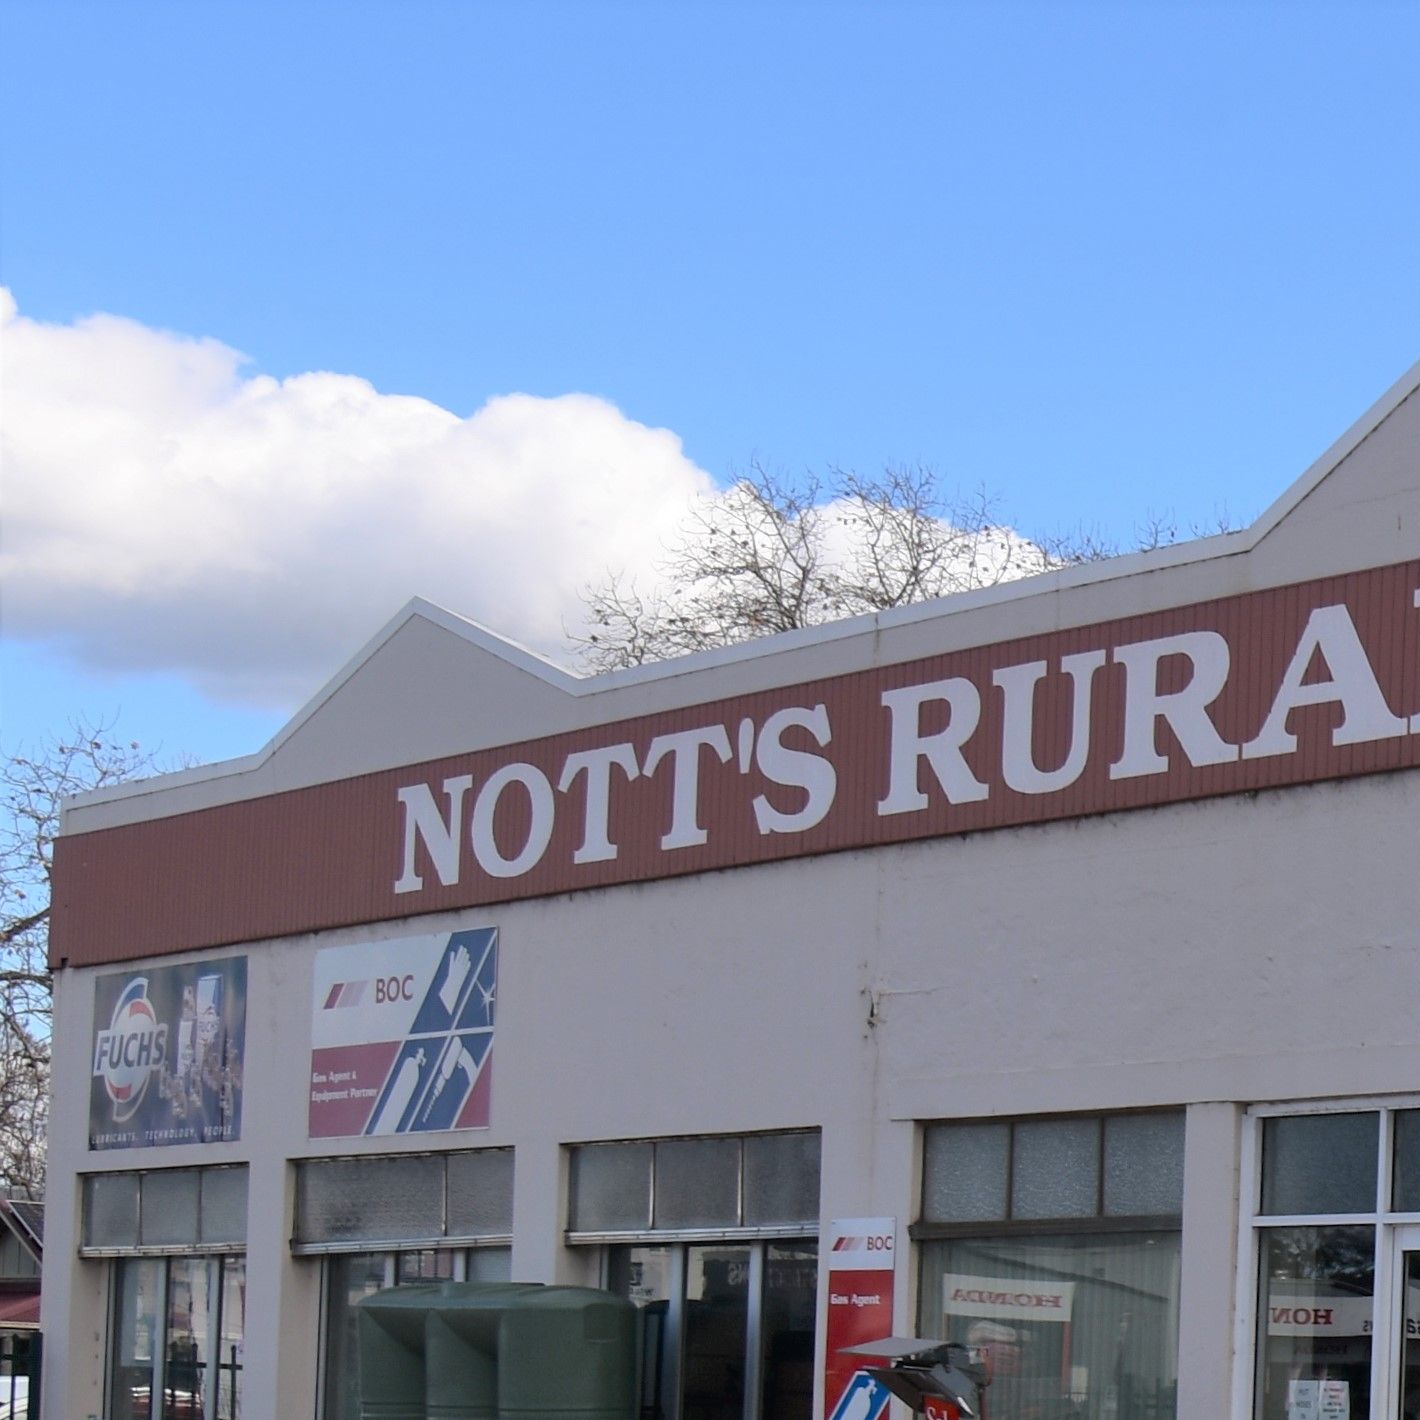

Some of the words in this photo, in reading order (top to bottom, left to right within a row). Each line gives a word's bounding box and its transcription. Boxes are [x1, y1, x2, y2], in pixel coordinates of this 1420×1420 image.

[393, 701, 838, 895] NOTT'S
[375, 974, 415, 1004] BOC
[96, 1029, 165, 1072] FUCHS
[312, 1072, 327, 1084] Gas
[329, 1071, 351, 1084] Agent
[311, 1089, 348, 1104] Equipment
[350, 1086, 379, 1099] Partner
[867, 1235, 893, 1251] BOC
[830, 1293, 849, 1305] Gas
[851, 1293, 881, 1307] Agent
